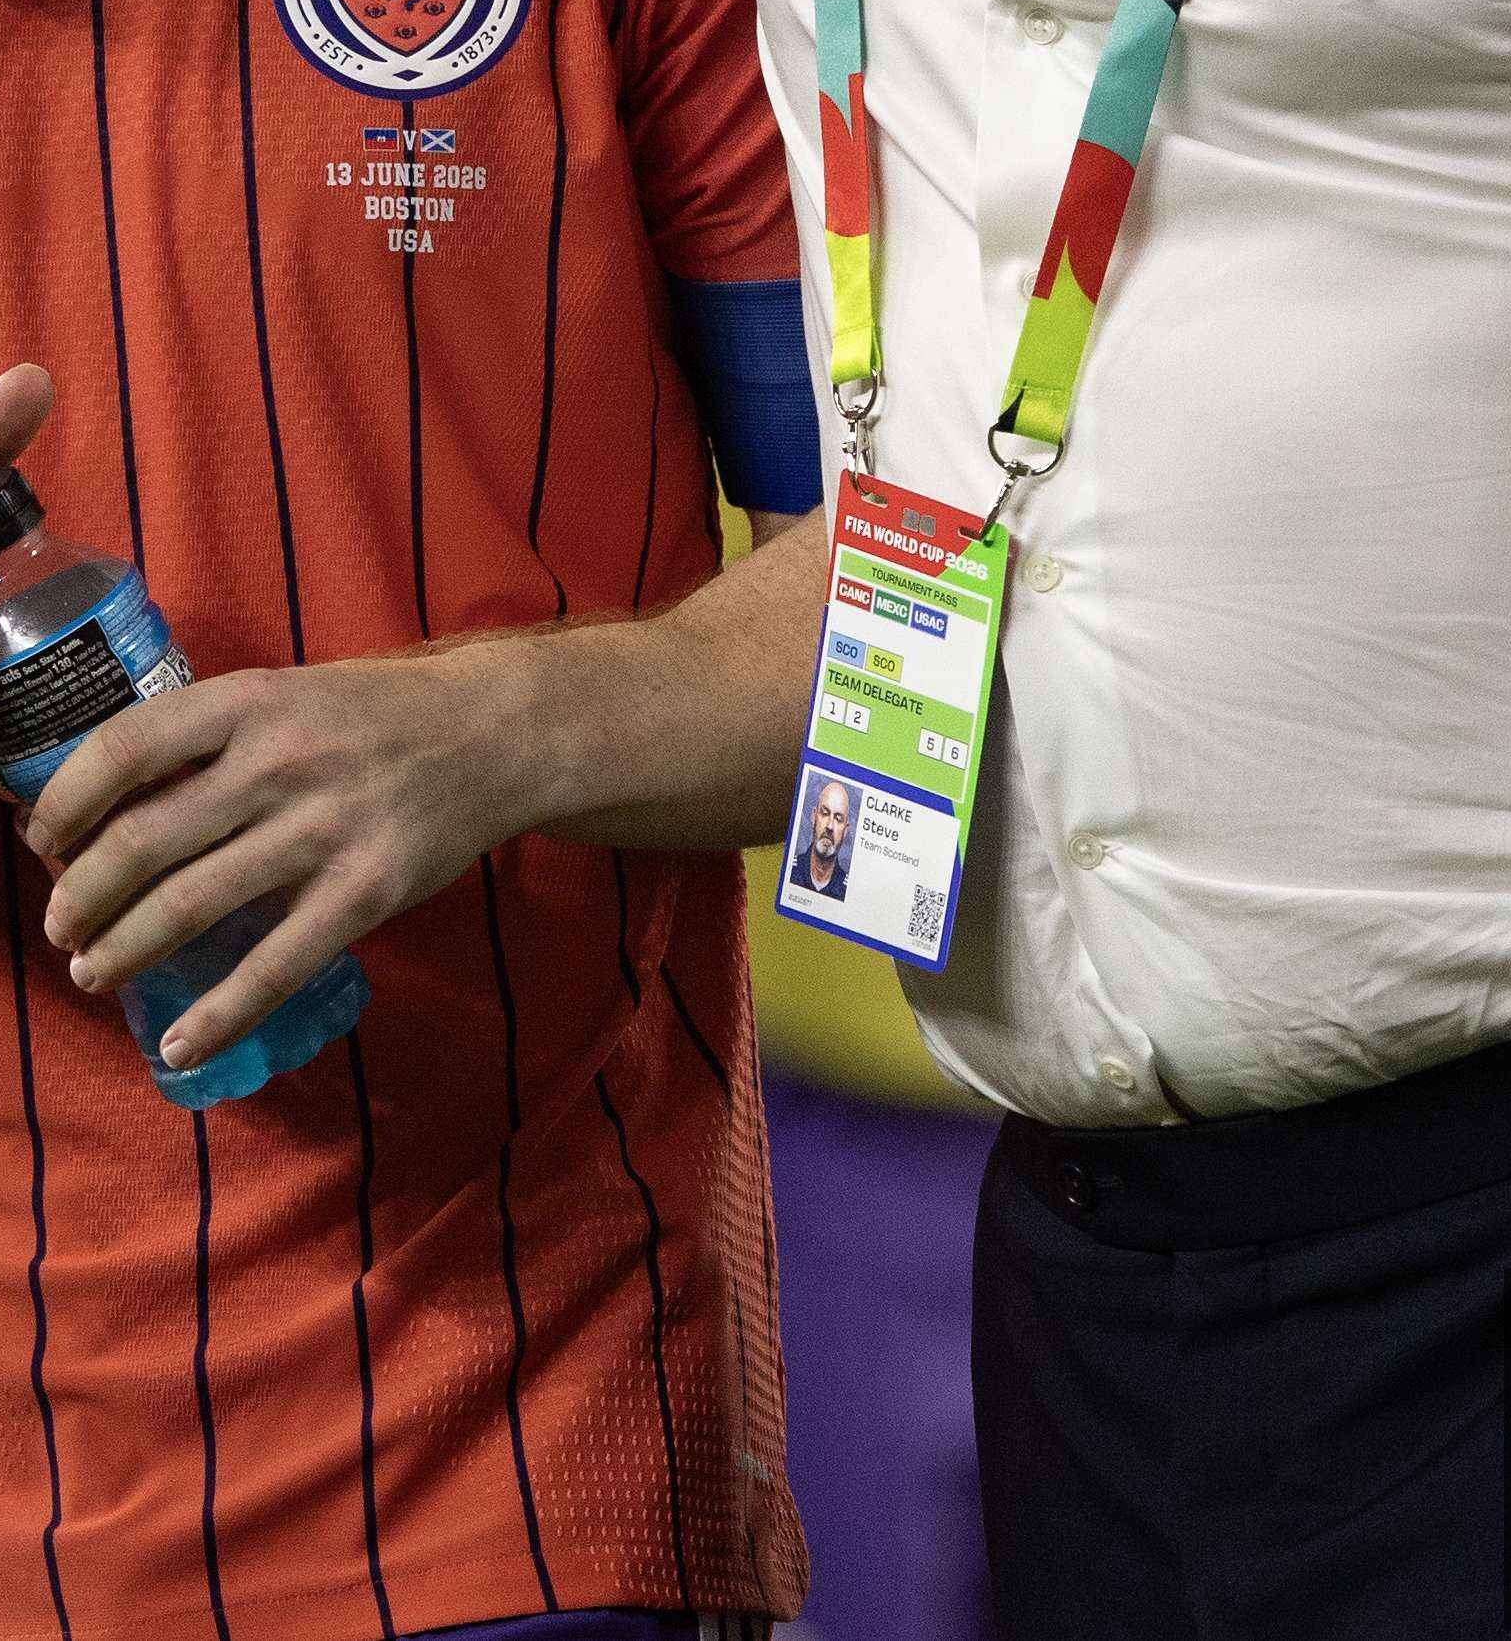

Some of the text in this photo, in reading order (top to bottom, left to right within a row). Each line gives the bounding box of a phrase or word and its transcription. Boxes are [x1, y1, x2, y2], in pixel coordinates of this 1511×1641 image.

[319, 31, 494, 67] EST 1873
[403, 130, 417, 151] V
[326, 162, 487, 190] 13 JUNE 2026
[364, 195, 456, 222] BOSTON
[387, 228, 435, 253] USA
[844, 514, 989, 581] FIFA WORLD CUP 2026
[871, 567, 959, 608] TOURNAMENT PASS
[876, 595, 909, 619] MEXC
[914, 609, 946, 633] USAC
[835, 640, 896, 673] SCO SCO
[828, 668, 925, 716] TEAM DELEGATE
[829, 701, 960, 760] 1 2 5 6
[866, 796, 913, 824] CLARKE
[862, 817, 899, 842] Steve
[860, 837, 883, 854] Team
